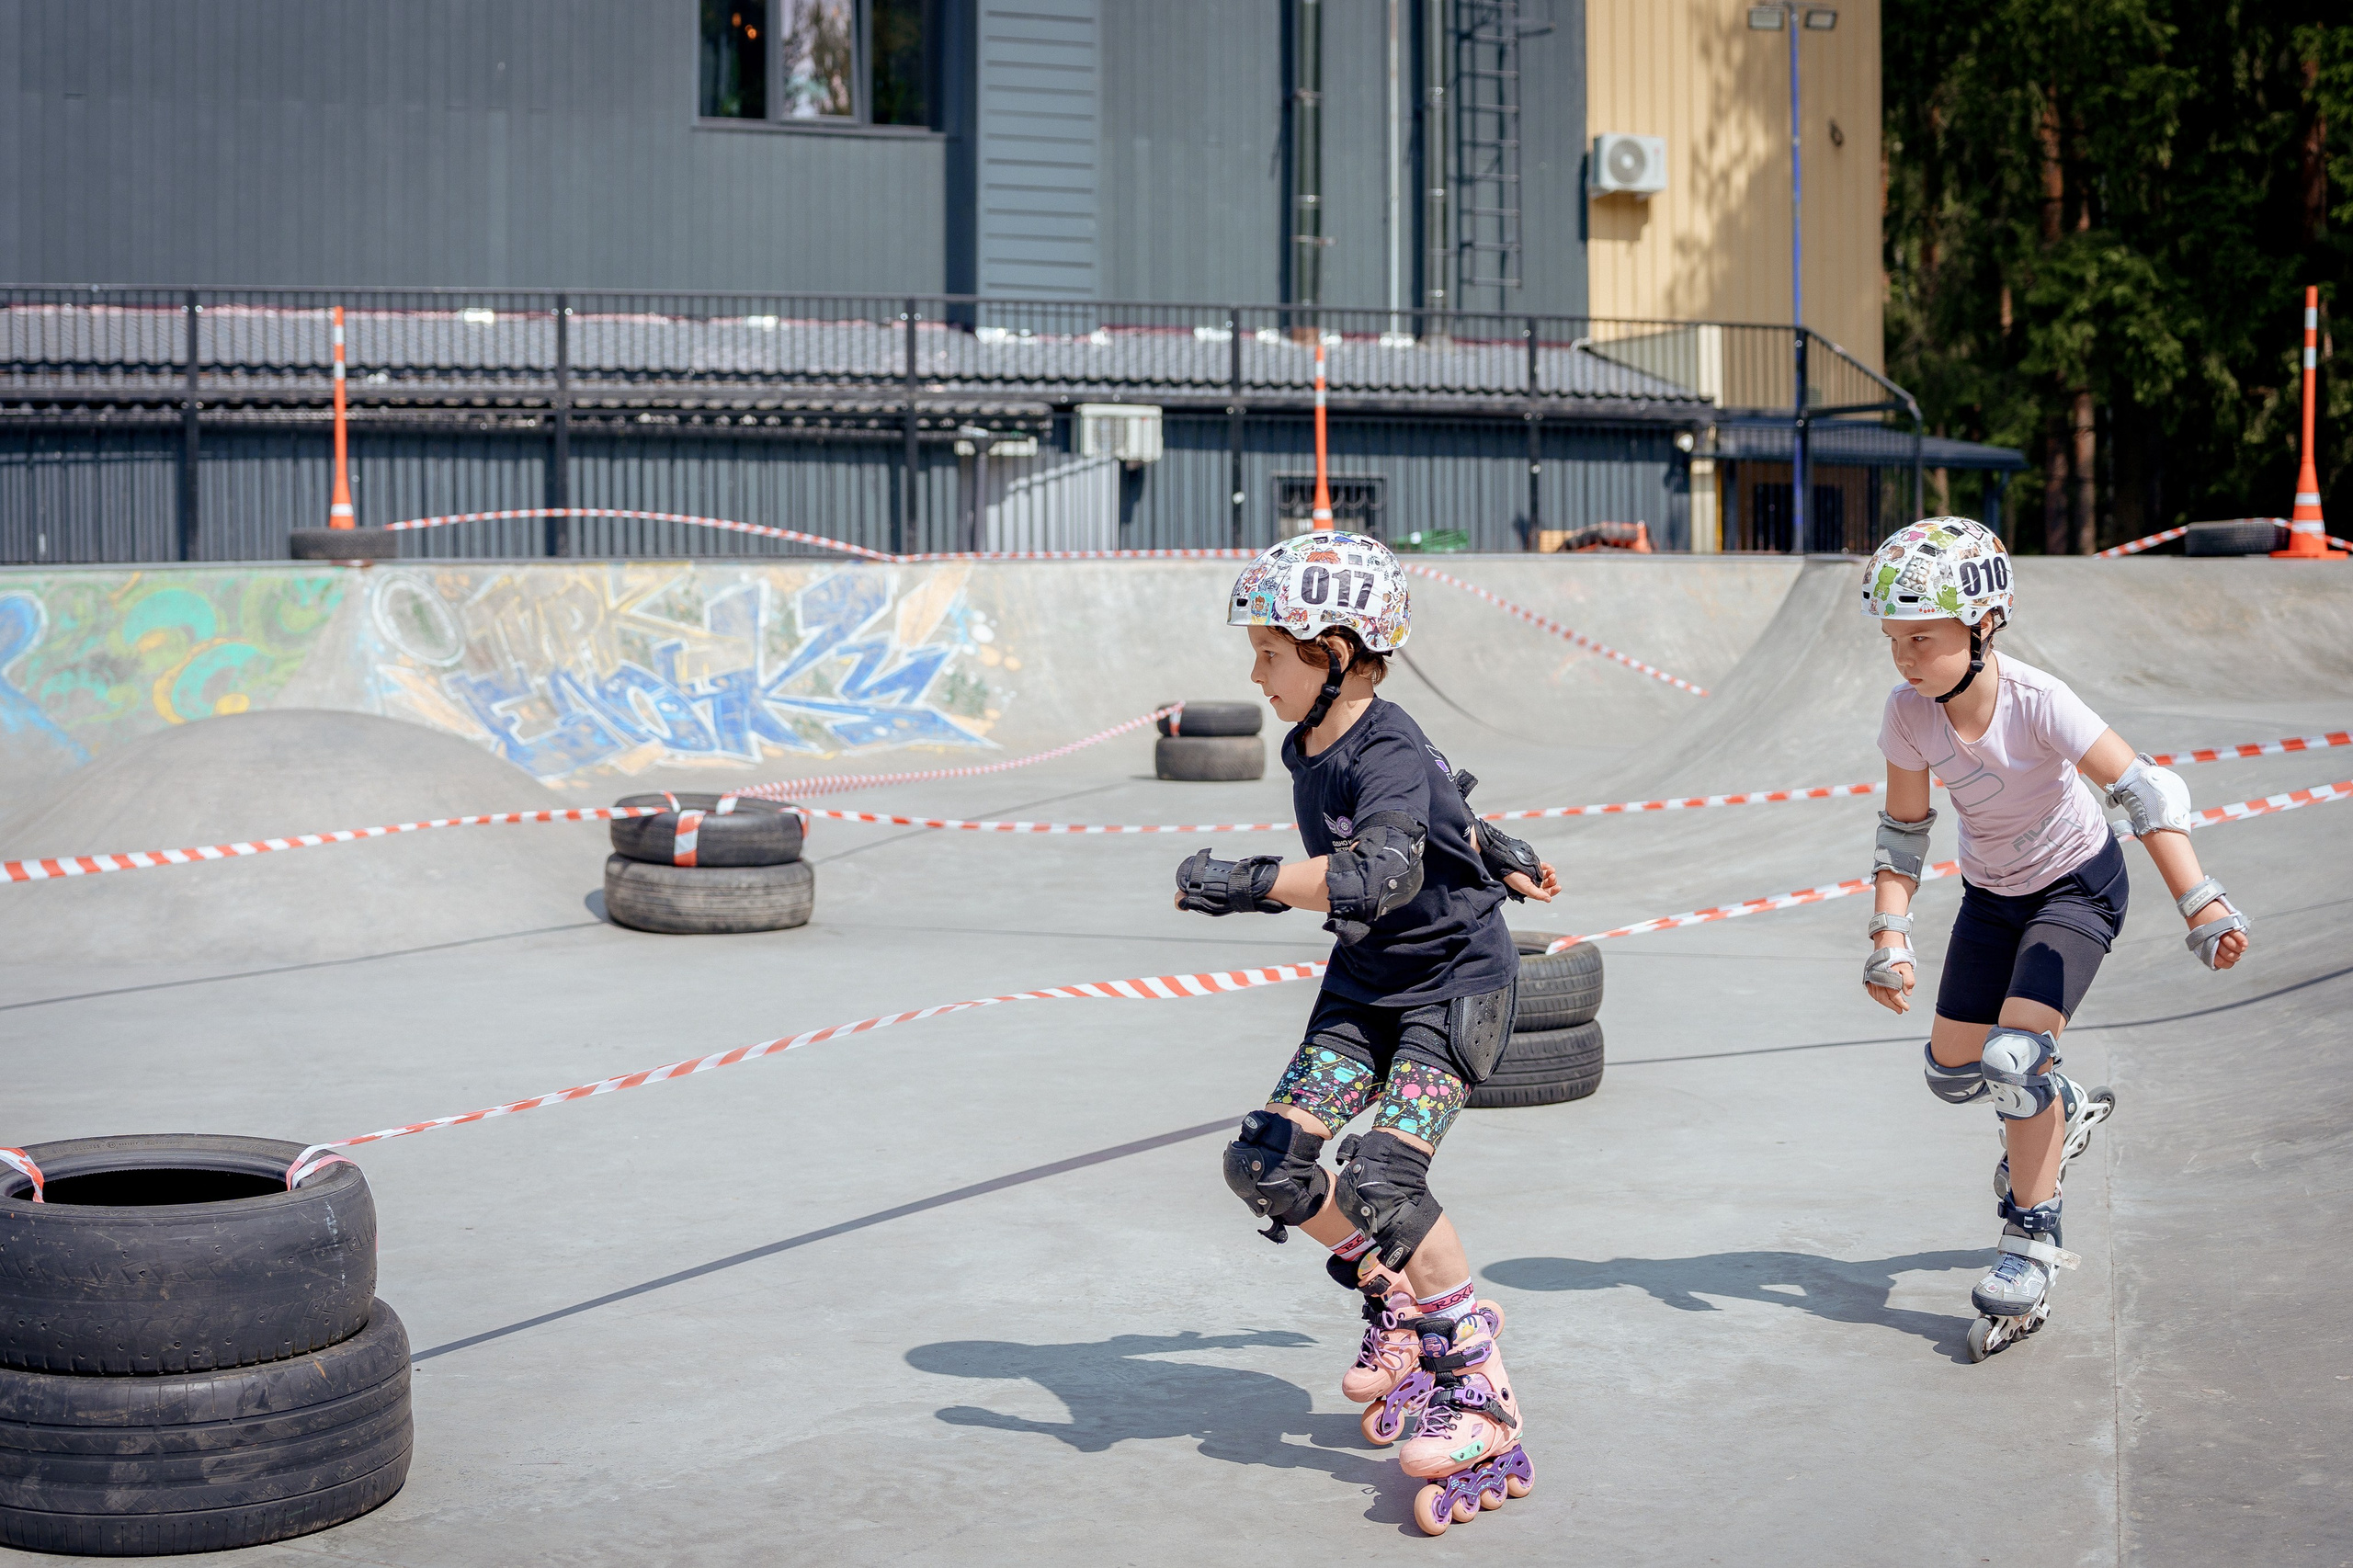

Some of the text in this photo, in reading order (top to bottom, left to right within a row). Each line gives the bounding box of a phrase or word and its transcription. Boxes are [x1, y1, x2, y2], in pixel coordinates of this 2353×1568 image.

[1301, 565, 1374, 610] 017
[1959, 556, 2008, 597] 010
[2011, 815, 2054, 852] FILA
